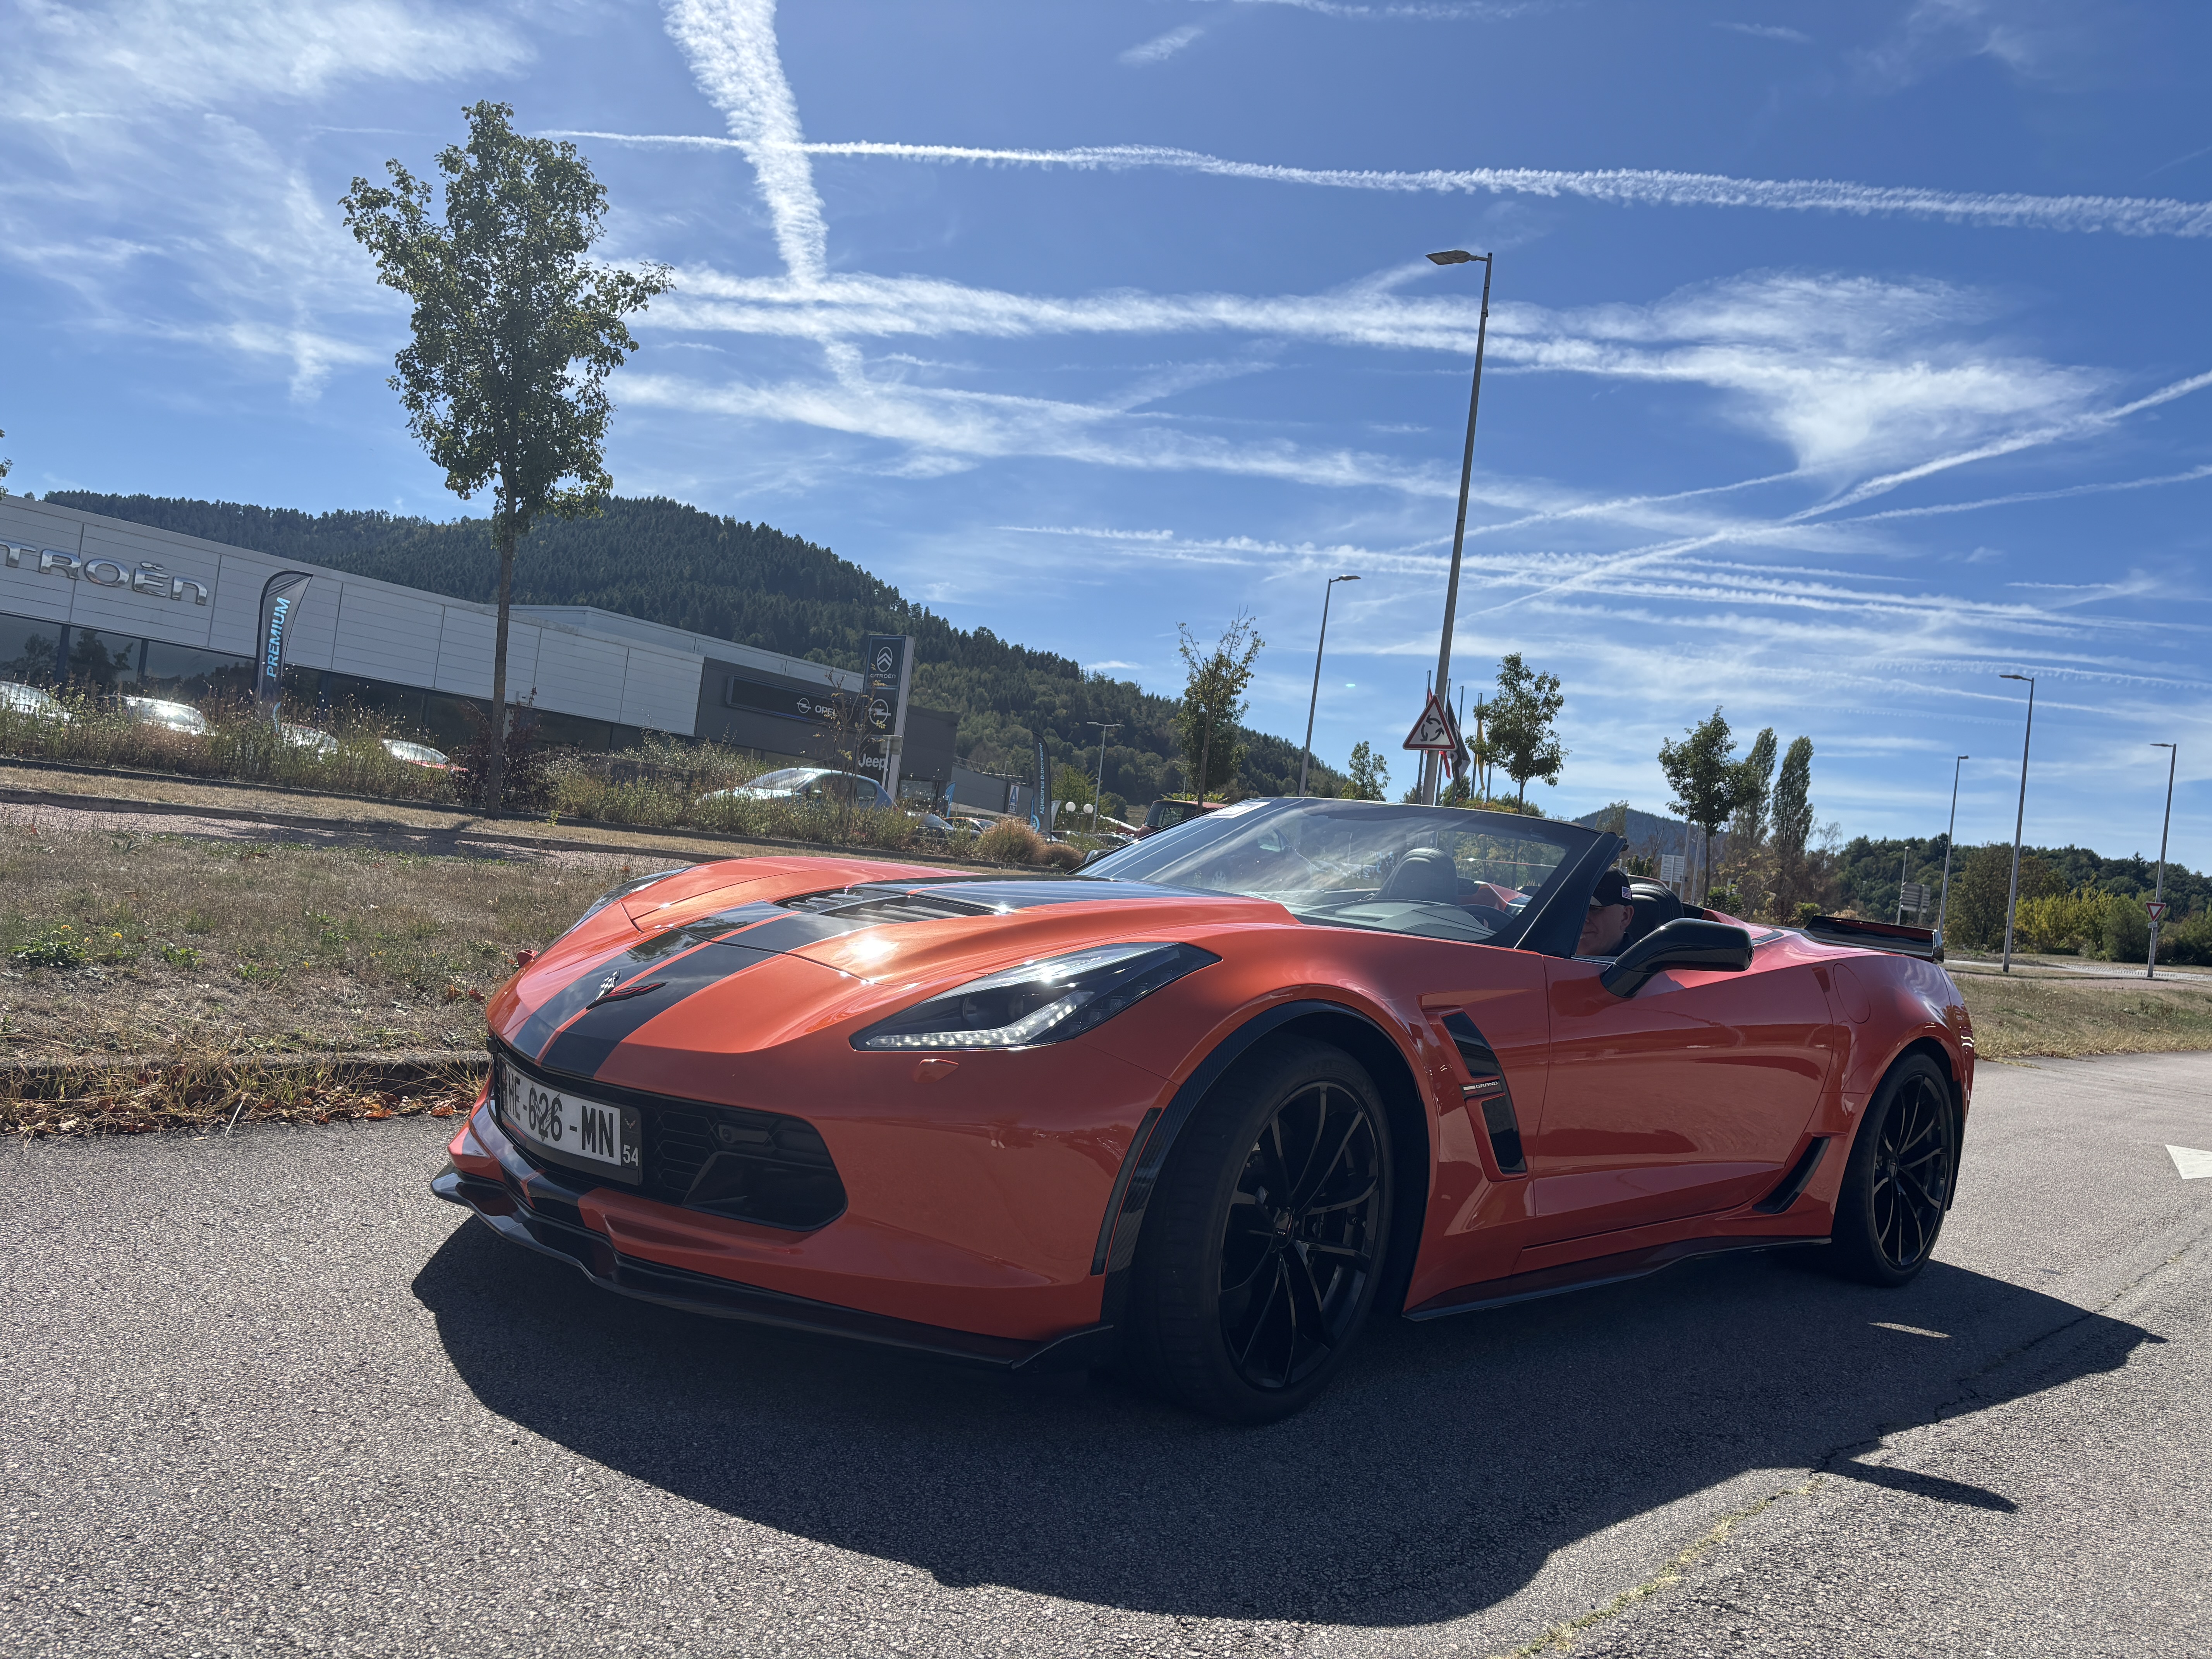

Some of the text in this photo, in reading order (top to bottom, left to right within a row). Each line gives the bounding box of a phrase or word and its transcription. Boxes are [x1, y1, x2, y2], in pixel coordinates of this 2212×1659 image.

[267, 597, 290, 678] PREMIUM
[815, 705, 836, 716] OPEL
[859, 753, 886, 770] Jeep
[623, 1144, 639, 1166] 54
